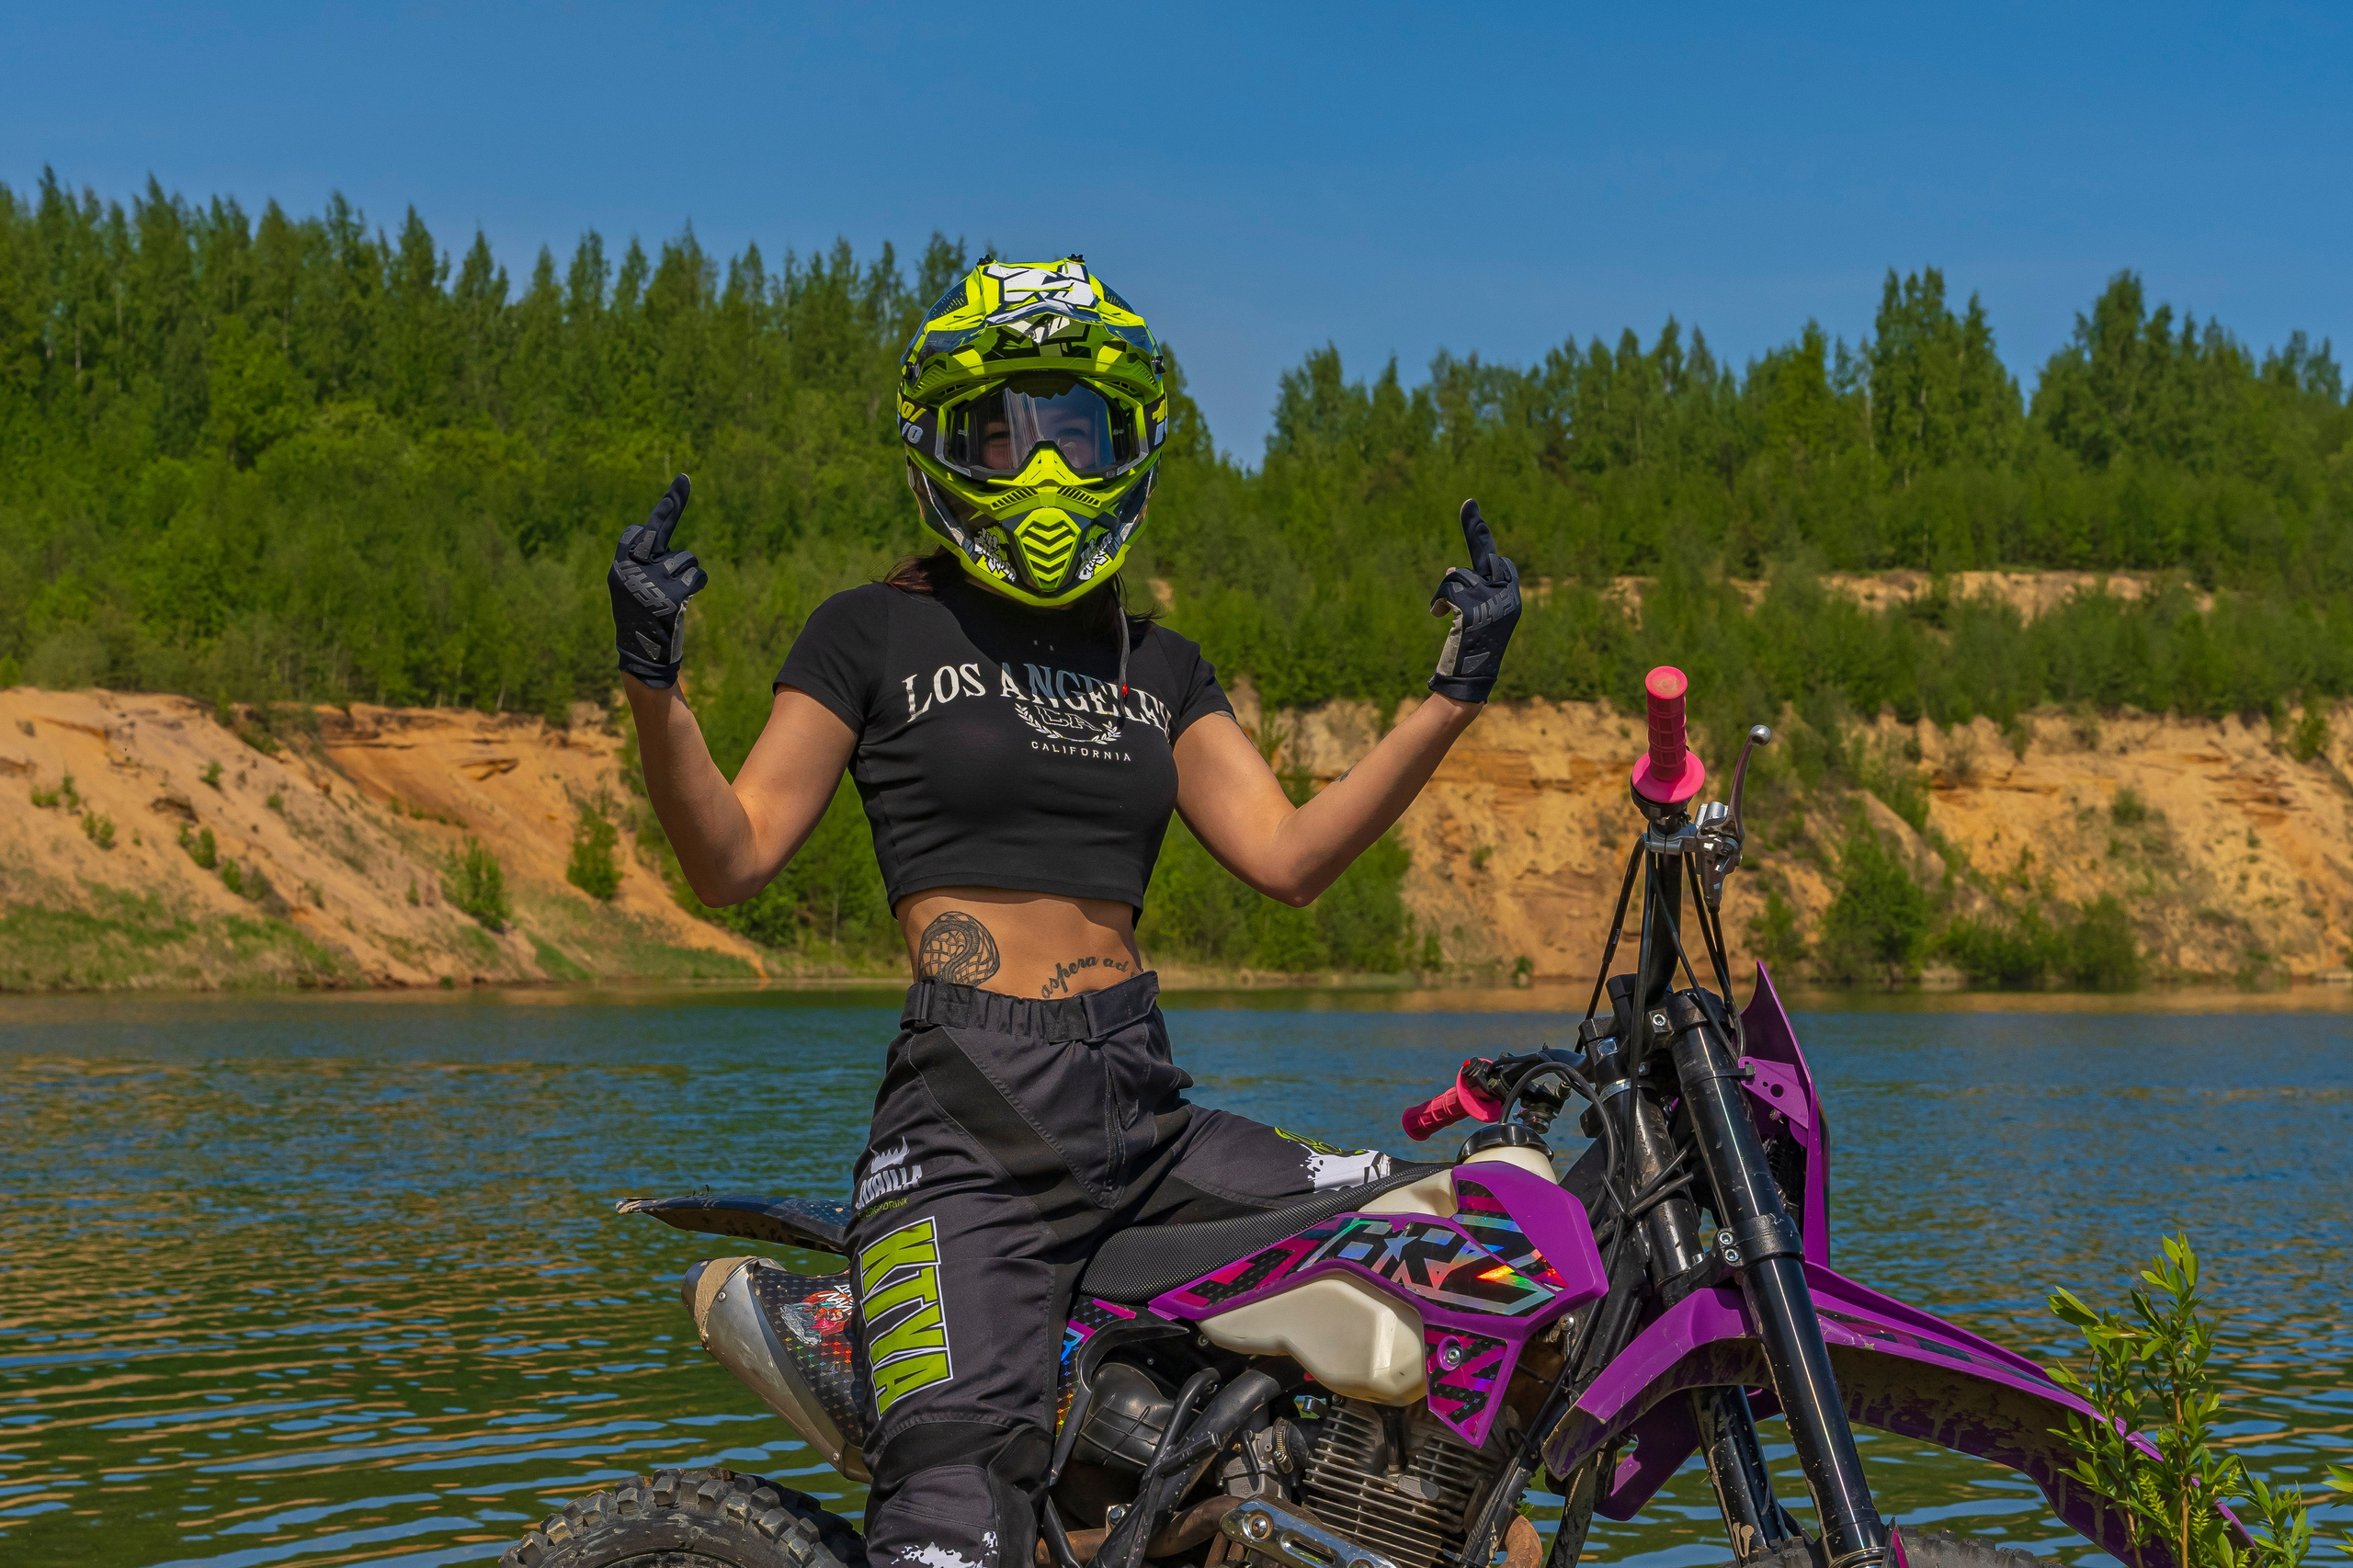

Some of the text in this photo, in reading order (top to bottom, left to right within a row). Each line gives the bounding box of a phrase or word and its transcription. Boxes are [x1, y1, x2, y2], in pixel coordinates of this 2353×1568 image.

[614, 560, 677, 618] LEATT
[1465, 582, 1520, 634] LEATT
[902, 663, 986, 723] LOS
[1031, 741, 1131, 762] CALIFORNIA
[1041, 956, 1130, 999] aspera ad
[858, 1217, 952, 1419] KTYA
